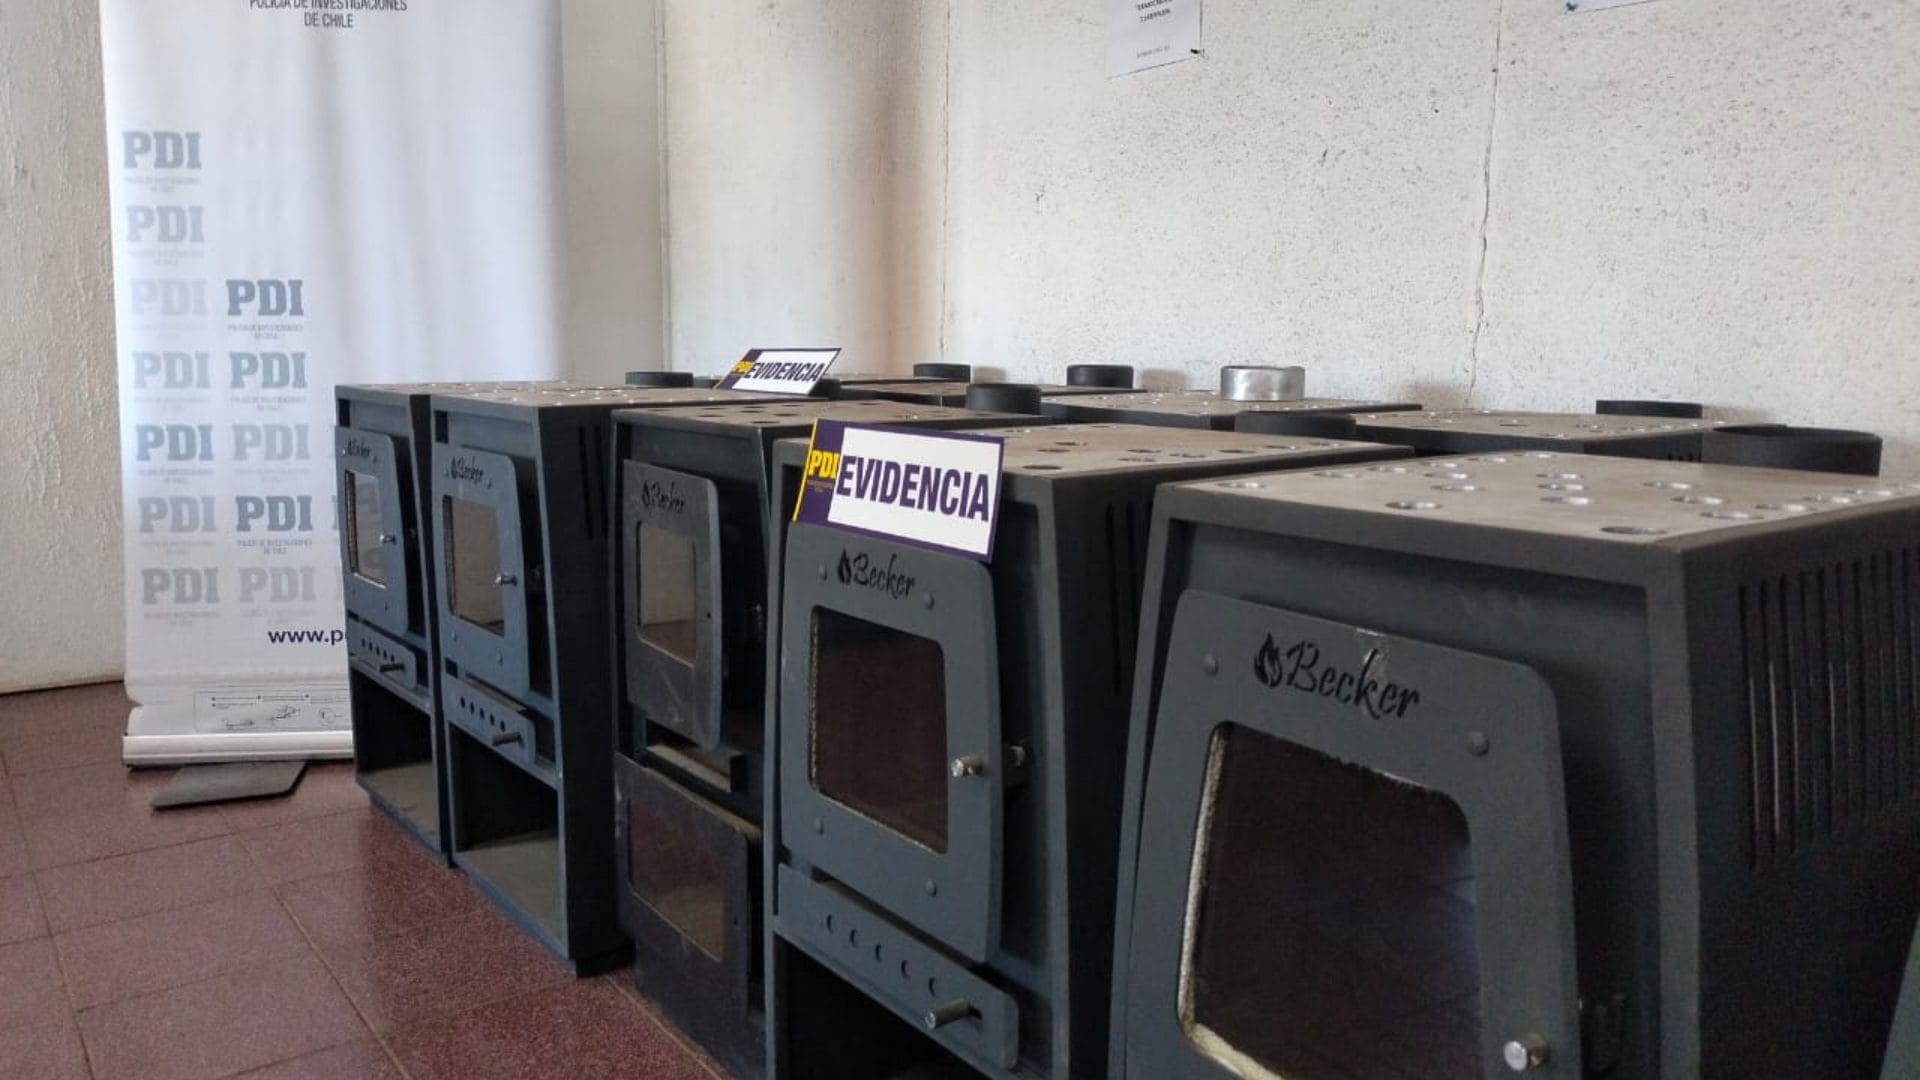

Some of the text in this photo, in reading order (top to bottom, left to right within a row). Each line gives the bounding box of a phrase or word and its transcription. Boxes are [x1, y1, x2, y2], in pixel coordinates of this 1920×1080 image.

[304, 12, 354, 28] DE CHILE
[122, 131, 202, 169] PDI
[125, 205, 204, 243] PDI
[130, 279, 207, 316] PDI
[226, 279, 304, 316] PDI
[132, 352, 210, 389] PDI
[229, 352, 307, 389] PDI
[743, 362, 825, 382] EVIDENCIA
[136, 424, 213, 461] PDI
[232, 424, 310, 460] PDI
[808, 450, 989, 522] PDI EVIDENCIA
[138, 496, 216, 533] PDI
[235, 495, 313, 531] PDI
[141, 566, 220, 604] PDI
[238, 566, 316, 603] PDI
[853, 552, 915, 600] Becker
[268, 629, 344, 646] www.p
[1286, 641, 1419, 720] Becker
